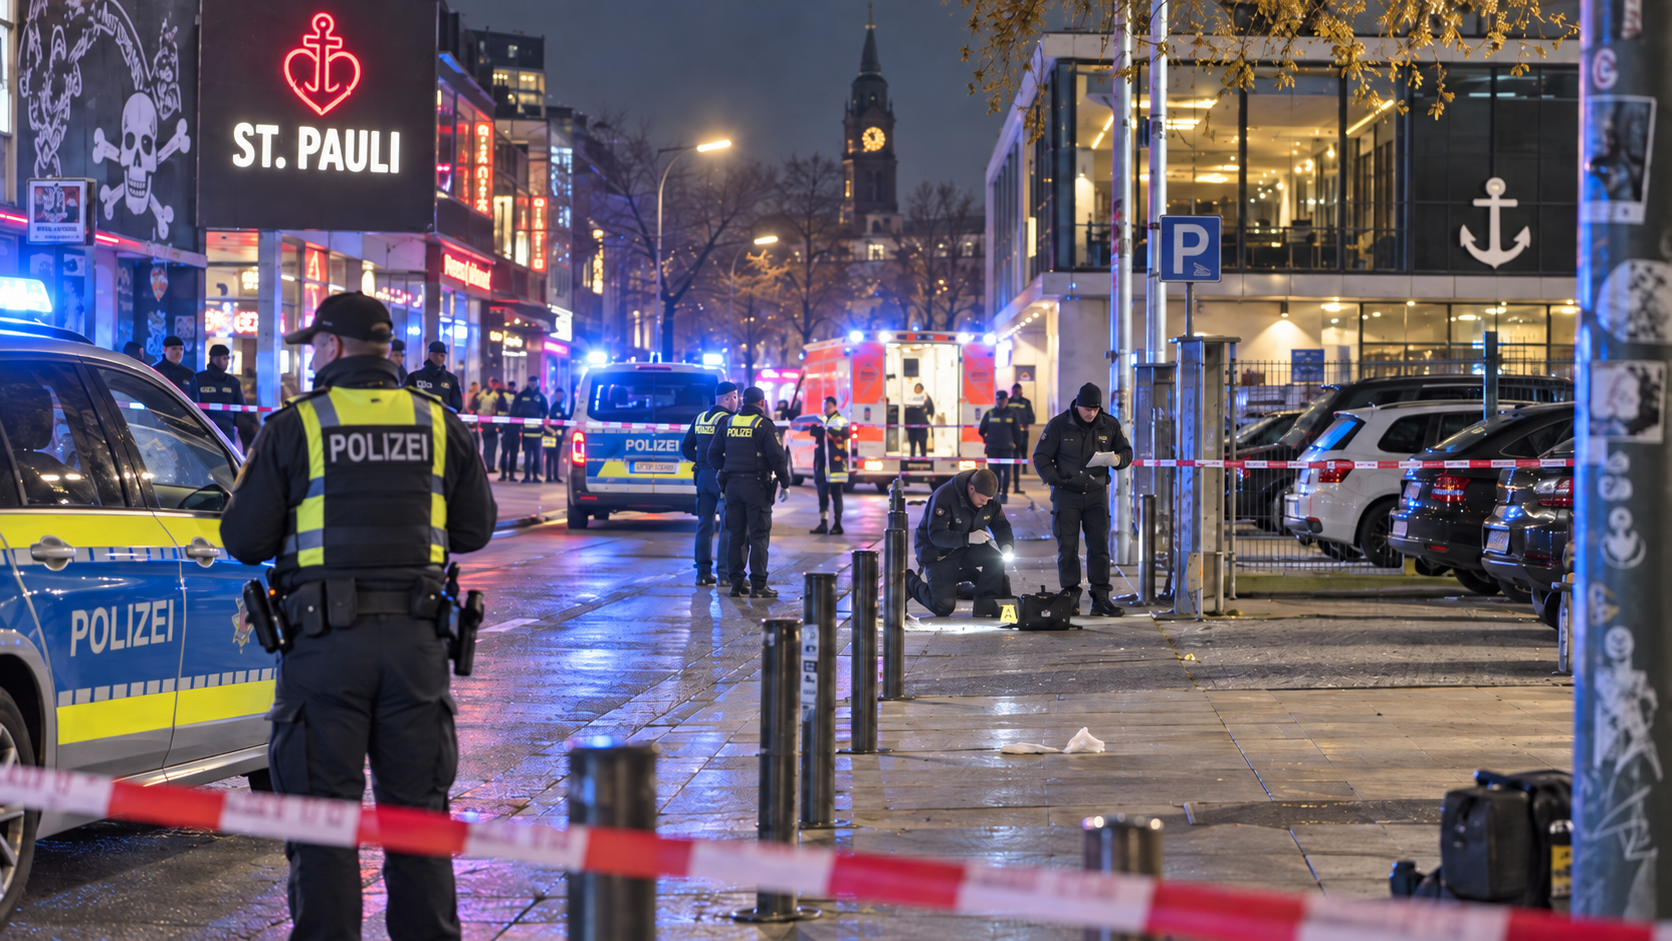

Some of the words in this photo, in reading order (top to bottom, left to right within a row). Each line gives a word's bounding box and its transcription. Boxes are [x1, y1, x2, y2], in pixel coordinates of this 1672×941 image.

[232, 122, 287, 169] ST.
[298, 126, 400, 174] PAULI
[1173, 223, 1210, 274] P
[329, 432, 429, 463] POLIZEI
[625, 439, 680, 452] POLIZEI
[727, 428, 753, 437] POLIZEI
[70, 599, 174, 657] POLIZEI
[1004, 608, 1013, 619] A
